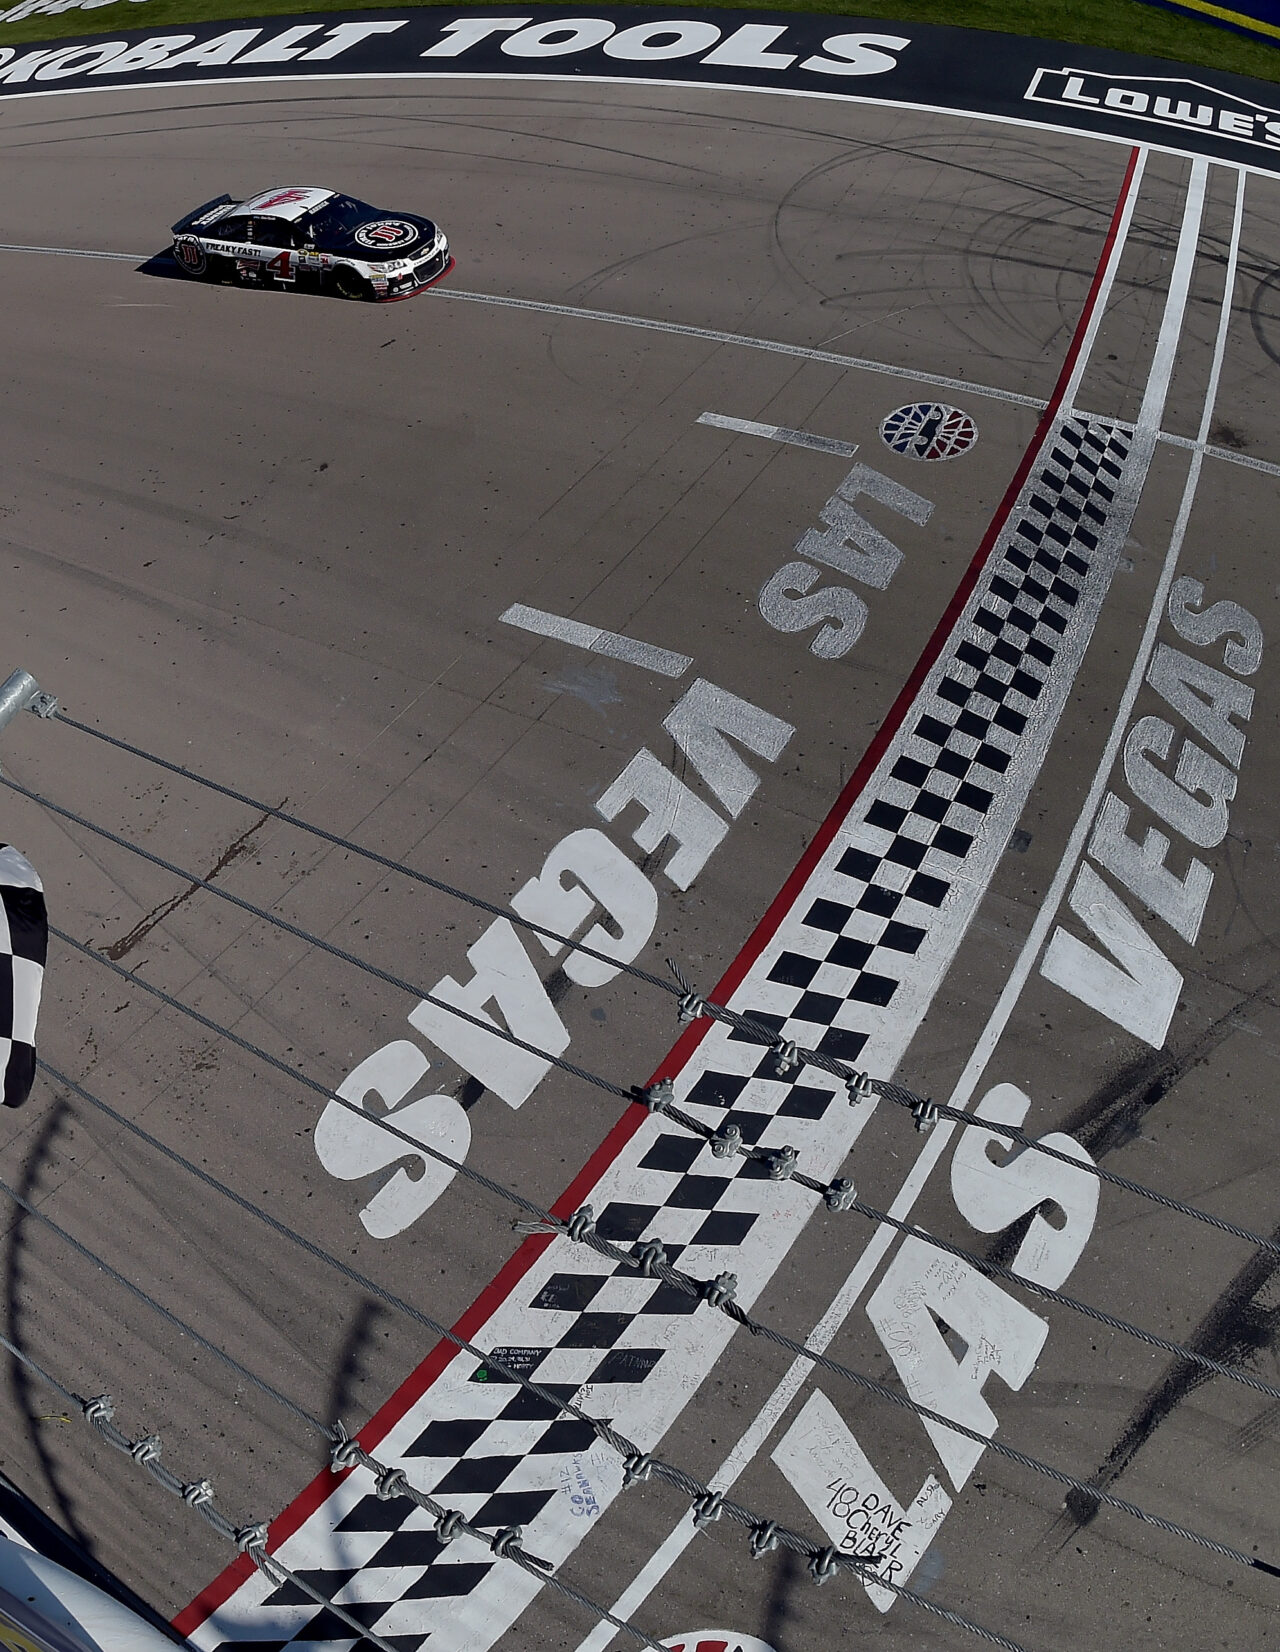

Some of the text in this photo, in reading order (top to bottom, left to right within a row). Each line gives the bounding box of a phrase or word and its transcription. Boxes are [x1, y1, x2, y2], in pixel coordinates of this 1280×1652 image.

[420, 17, 912, 76] TOOLS
[205, 242, 237, 256] FREAKY
[237, 247, 262, 257] FAST!
[266, 251, 296, 282] 4
[313, 462, 936, 1239] LAS VEGAS
[770, 576, 1263, 1613] LAS VEGAS
[826, 1477, 859, 1518] 48
[861, 1493, 912, 1542] DAVE
